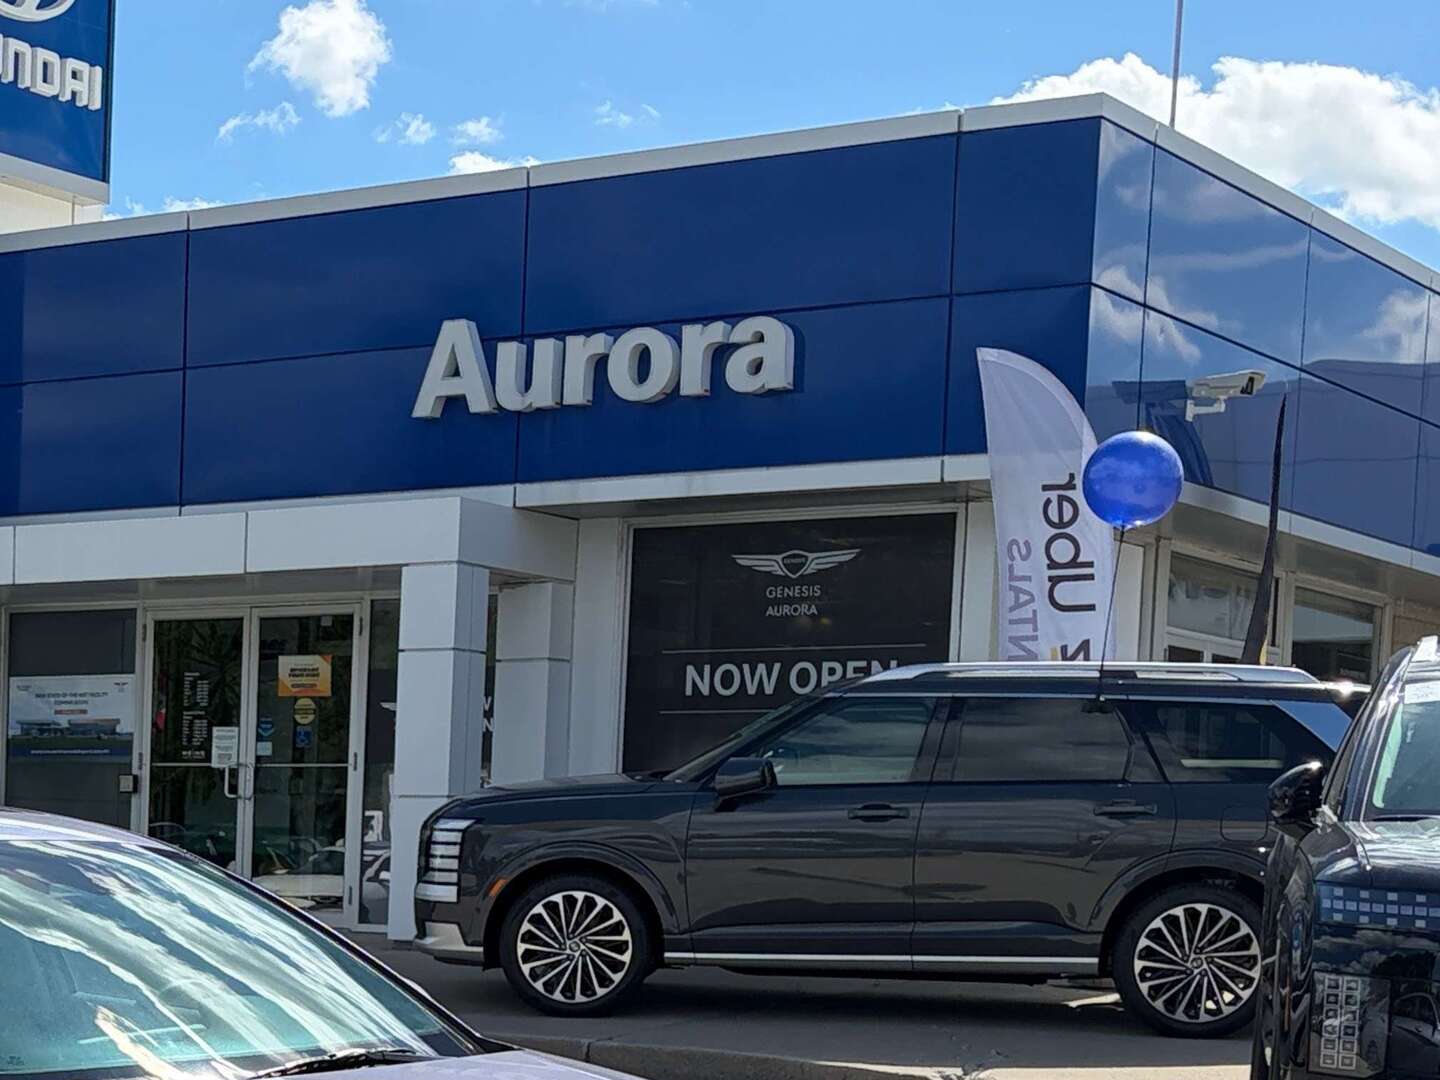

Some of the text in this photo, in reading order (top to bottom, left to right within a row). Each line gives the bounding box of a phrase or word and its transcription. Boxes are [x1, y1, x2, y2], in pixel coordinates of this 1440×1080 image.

[411, 315, 795, 418] Aurora
[766, 585, 822, 599] GENESIS
[765, 604, 818, 616] AURORA
[685, 662, 782, 697] NOW
